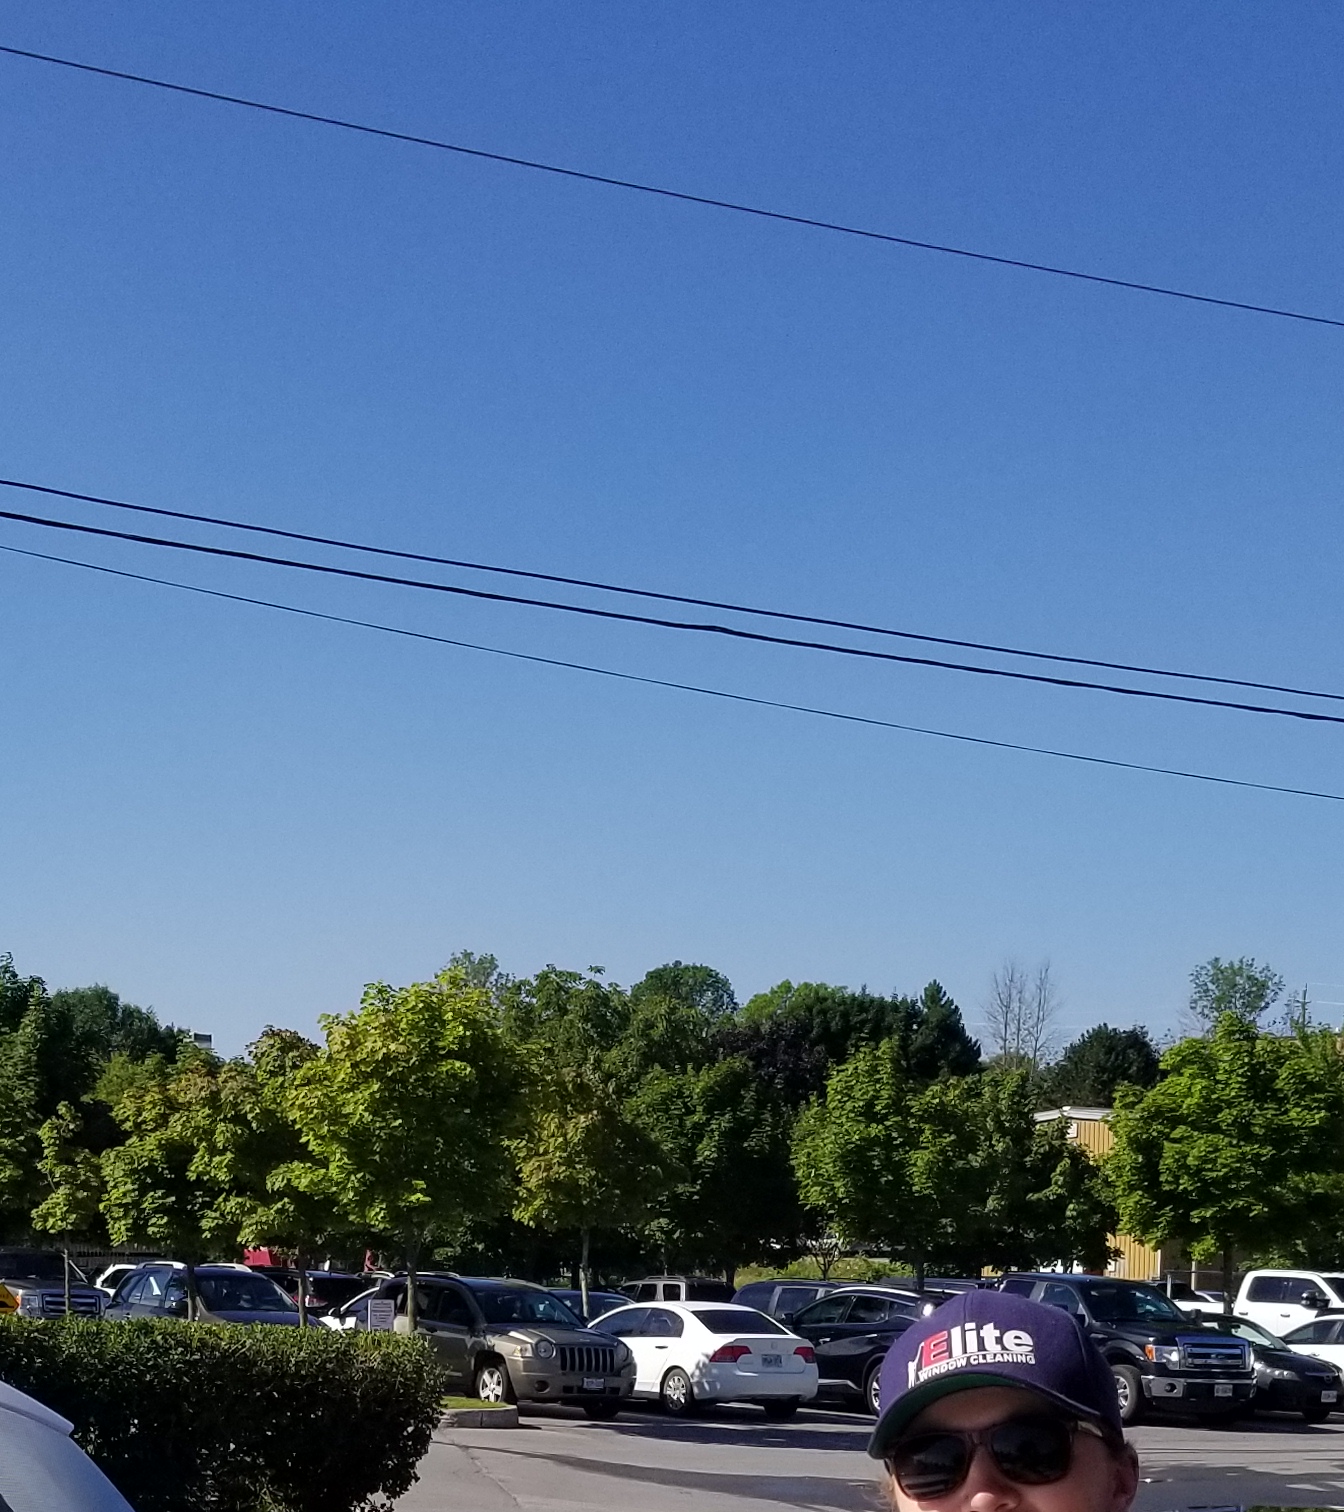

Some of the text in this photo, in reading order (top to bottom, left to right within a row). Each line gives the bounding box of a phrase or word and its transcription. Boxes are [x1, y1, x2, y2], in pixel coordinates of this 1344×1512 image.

[922, 1322, 1035, 1369] Elite
[917, 1352, 1036, 1384] WINDOW CLEANING
